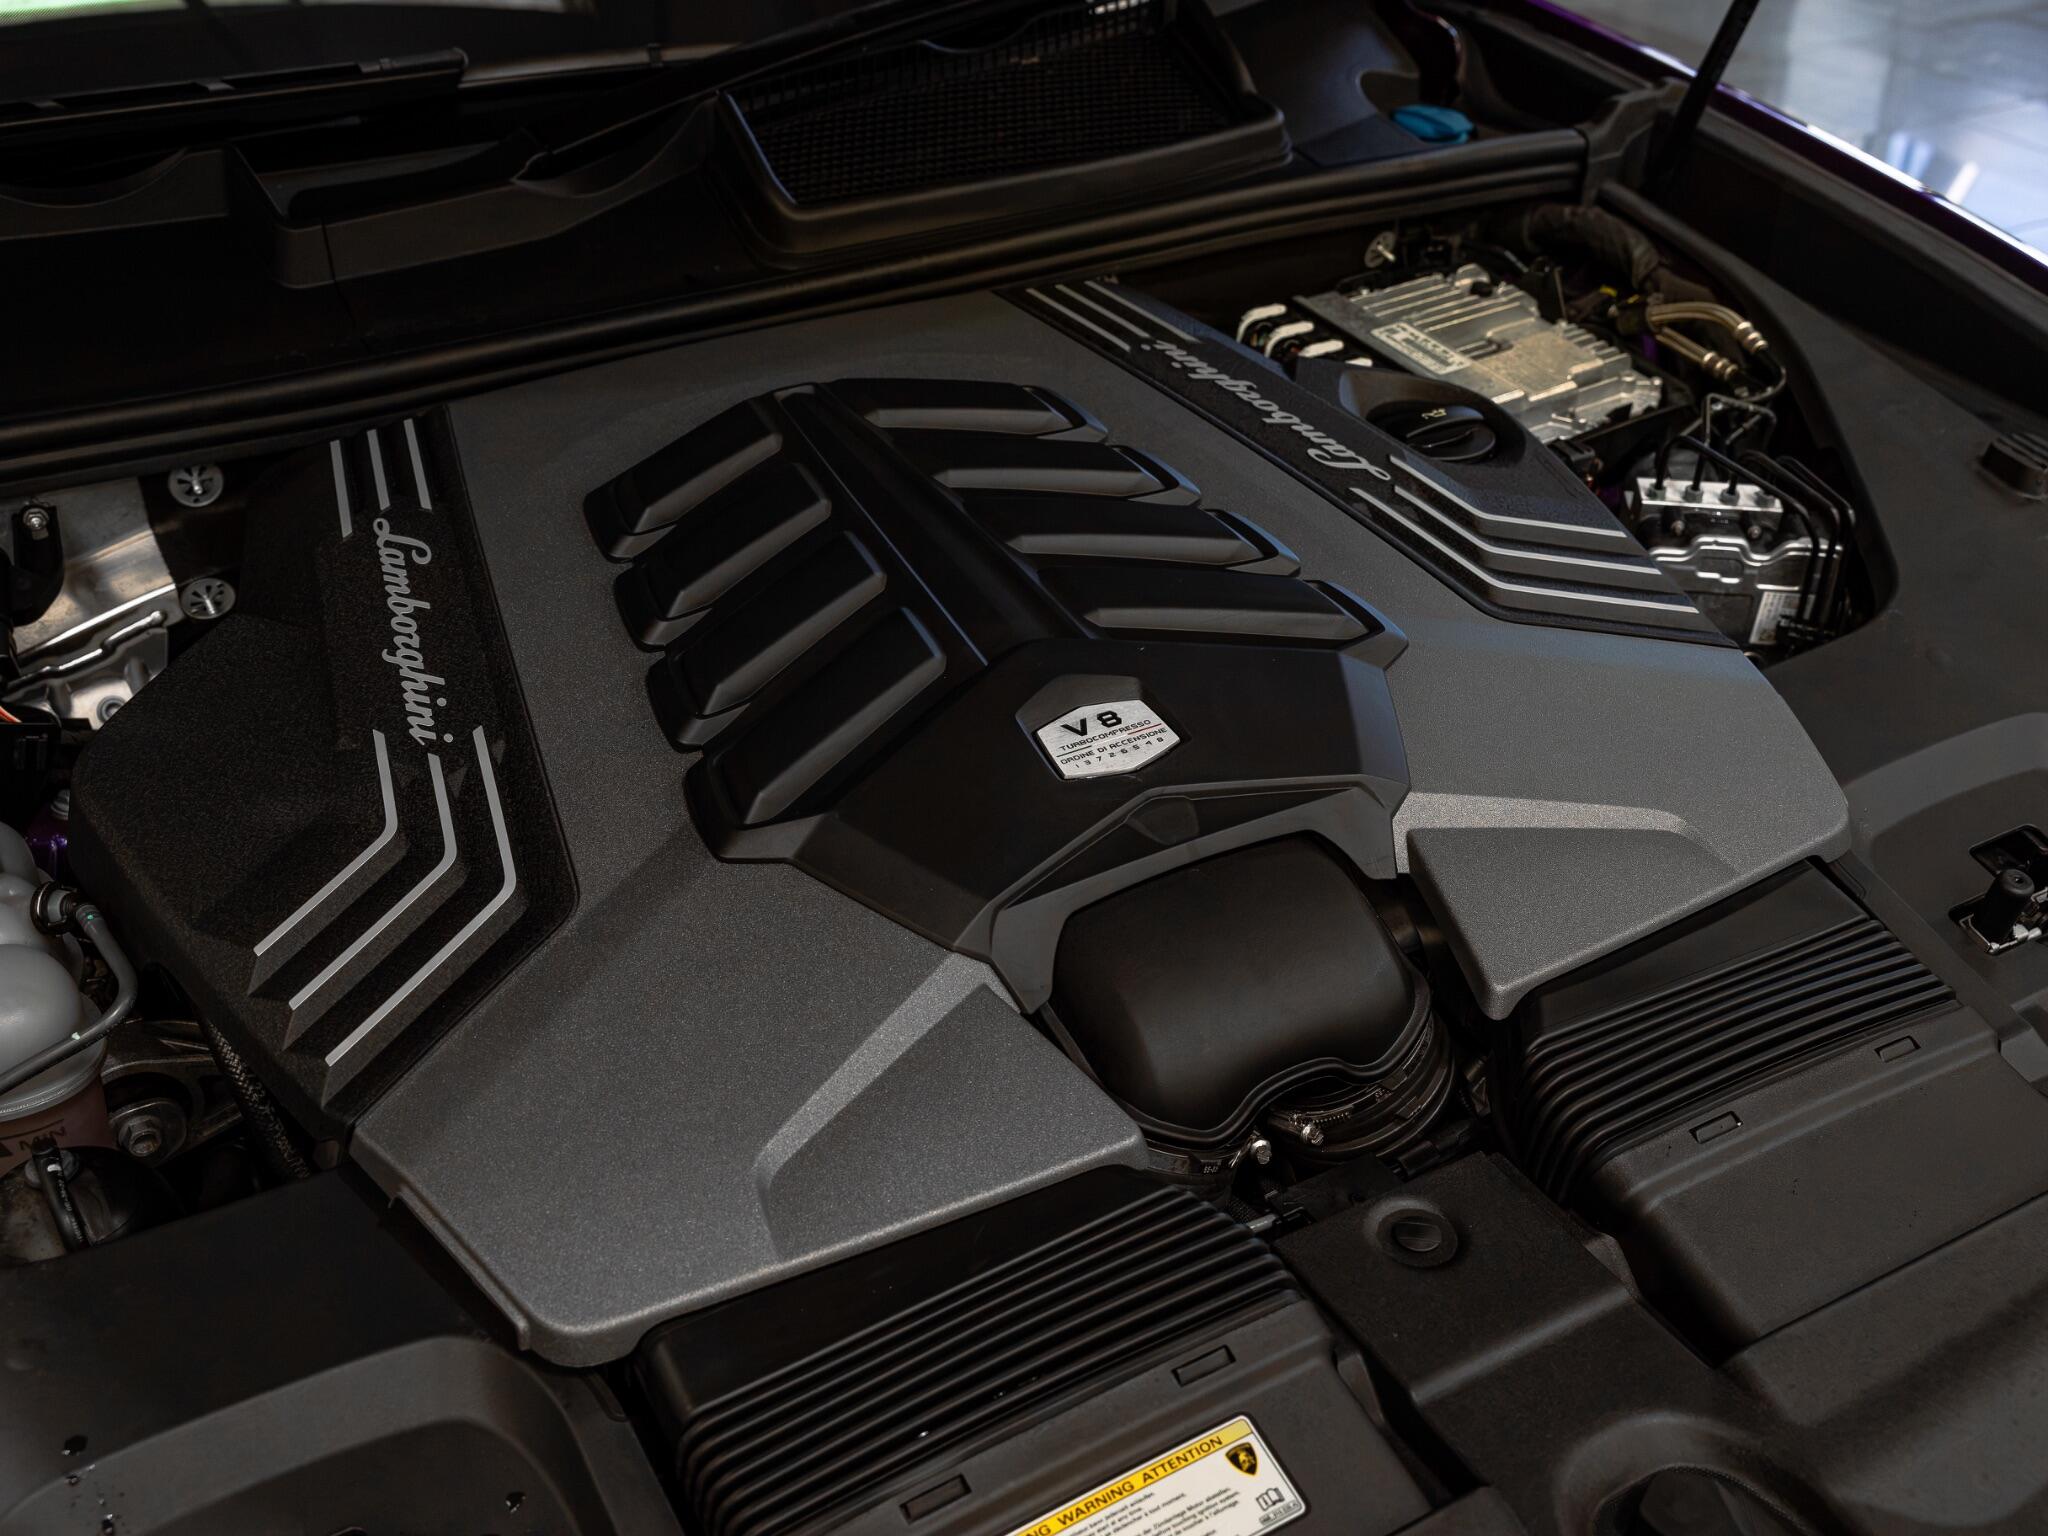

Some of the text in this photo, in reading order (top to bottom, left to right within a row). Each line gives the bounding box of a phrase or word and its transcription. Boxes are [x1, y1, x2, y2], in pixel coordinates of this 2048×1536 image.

[1140, 340, 1391, 481] Lamborghini
[372, 517, 454, 746] Lamborghini
[1060, 719, 1151, 751] TURBOCOMPRESSO
[1060, 750, 1096, 765] ORDINE
[1109, 727, 1168, 750] ACCENSIONE
[1057, 1481, 1135, 1526] WARNING
[1142, 1435, 1223, 1484] ATTENTION
